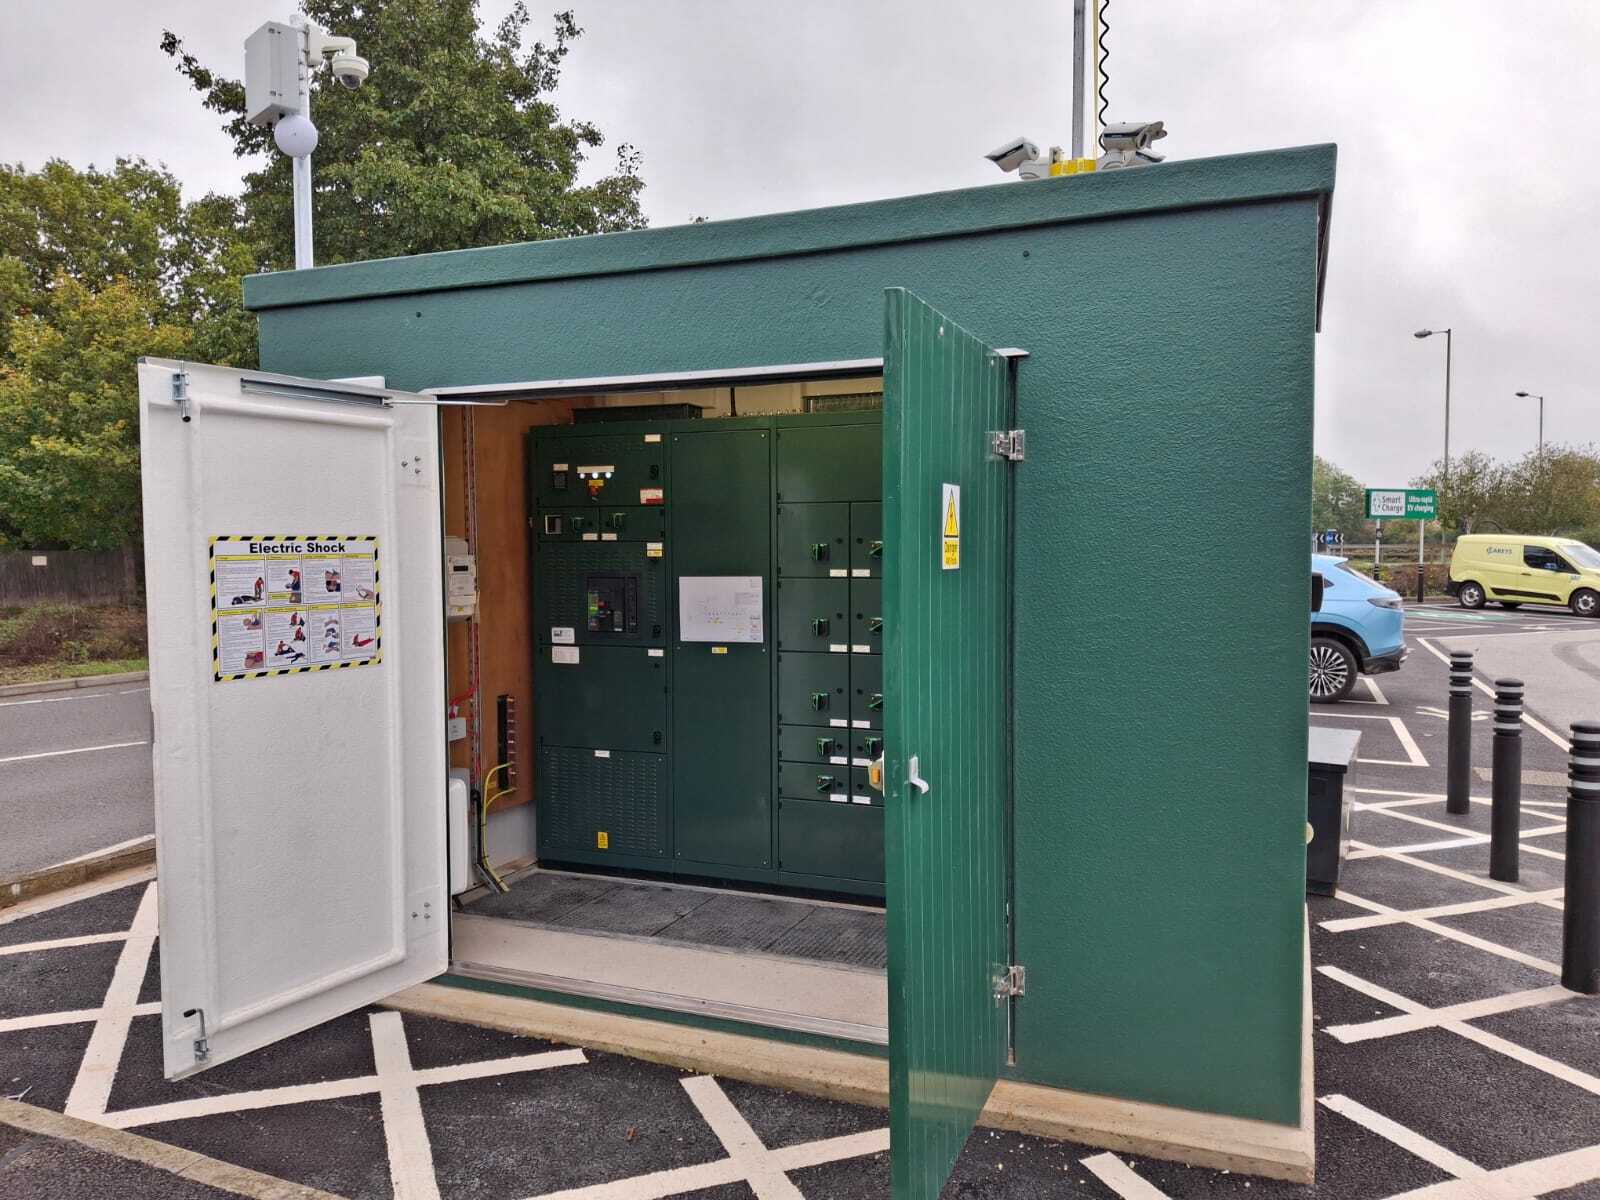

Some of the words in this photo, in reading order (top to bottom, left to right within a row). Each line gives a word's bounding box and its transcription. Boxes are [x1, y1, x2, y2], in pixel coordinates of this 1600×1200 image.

[1382, 504, 1403, 513] Charge
[250, 542, 302, 554] Electric
[307, 542, 346, 553] Shock
